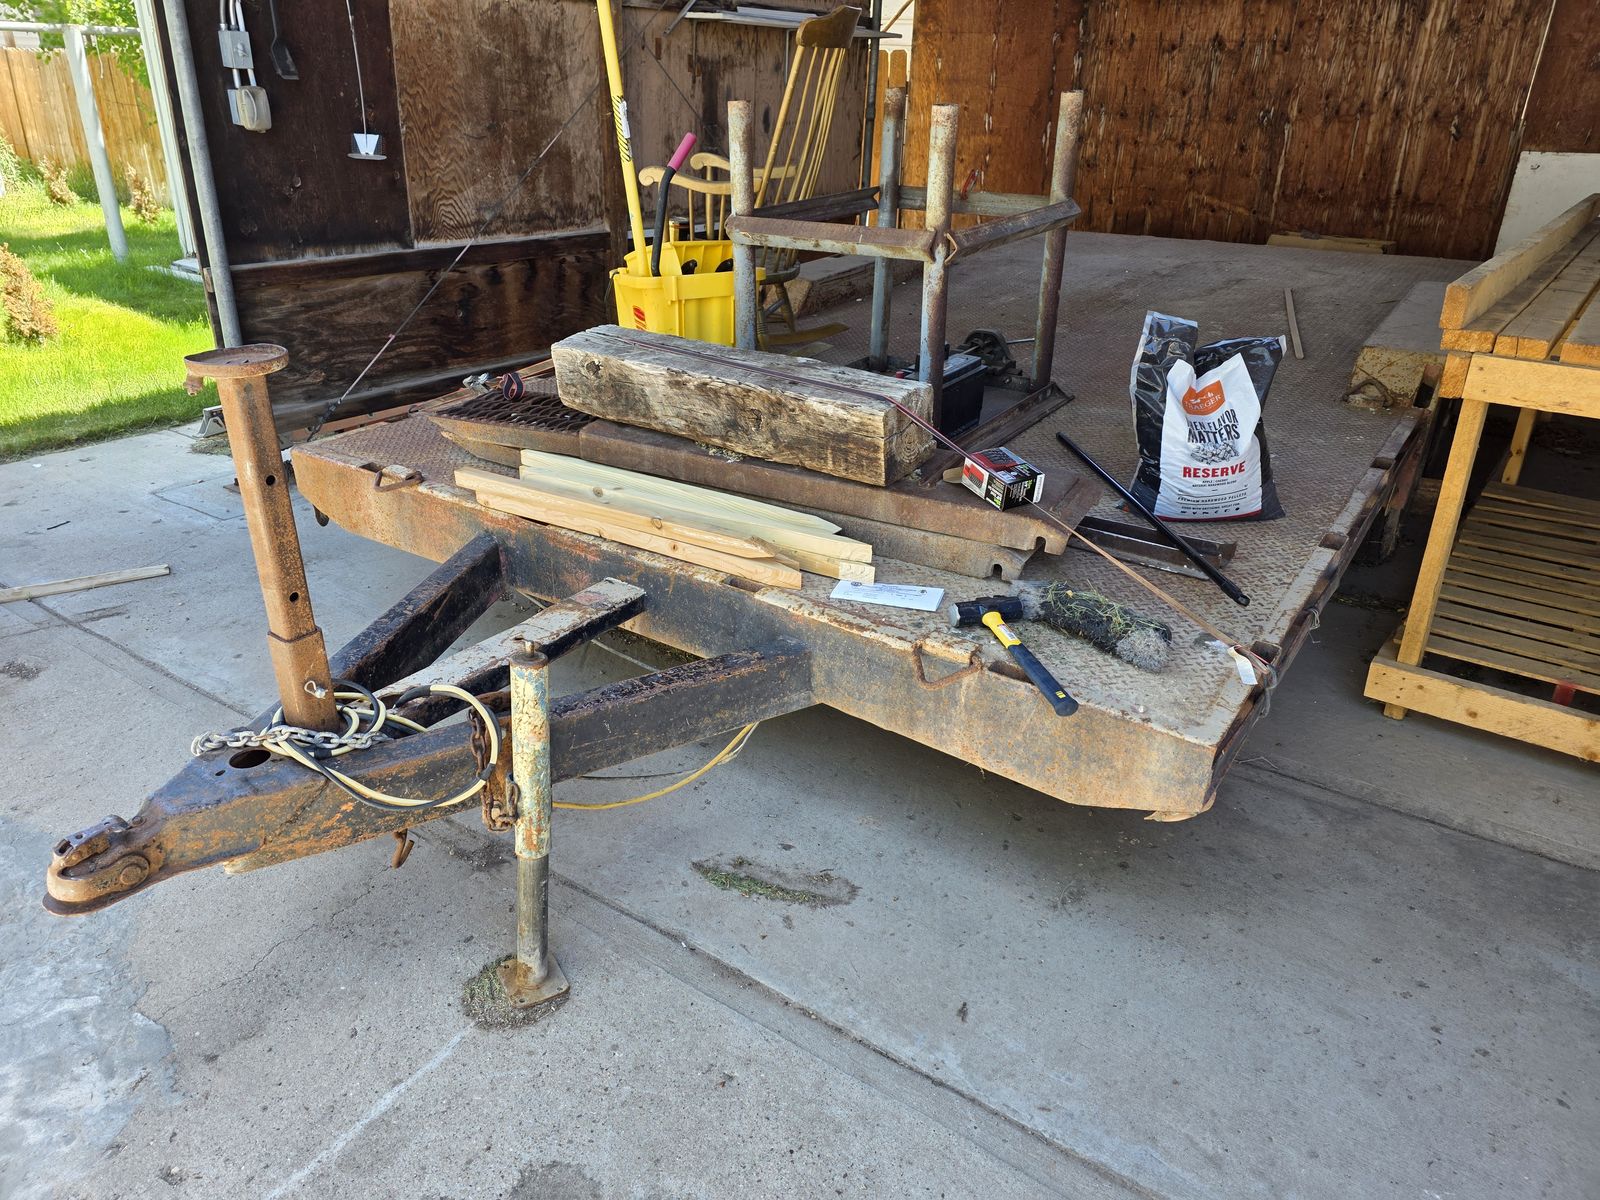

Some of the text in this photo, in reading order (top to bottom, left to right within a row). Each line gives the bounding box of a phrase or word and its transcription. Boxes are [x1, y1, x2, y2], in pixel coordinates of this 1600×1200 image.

[1207, 409, 1239, 431] FLAVOR
[1187, 424, 1241, 444] MATTERS
[1182, 461, 1246, 478] RESERVE
